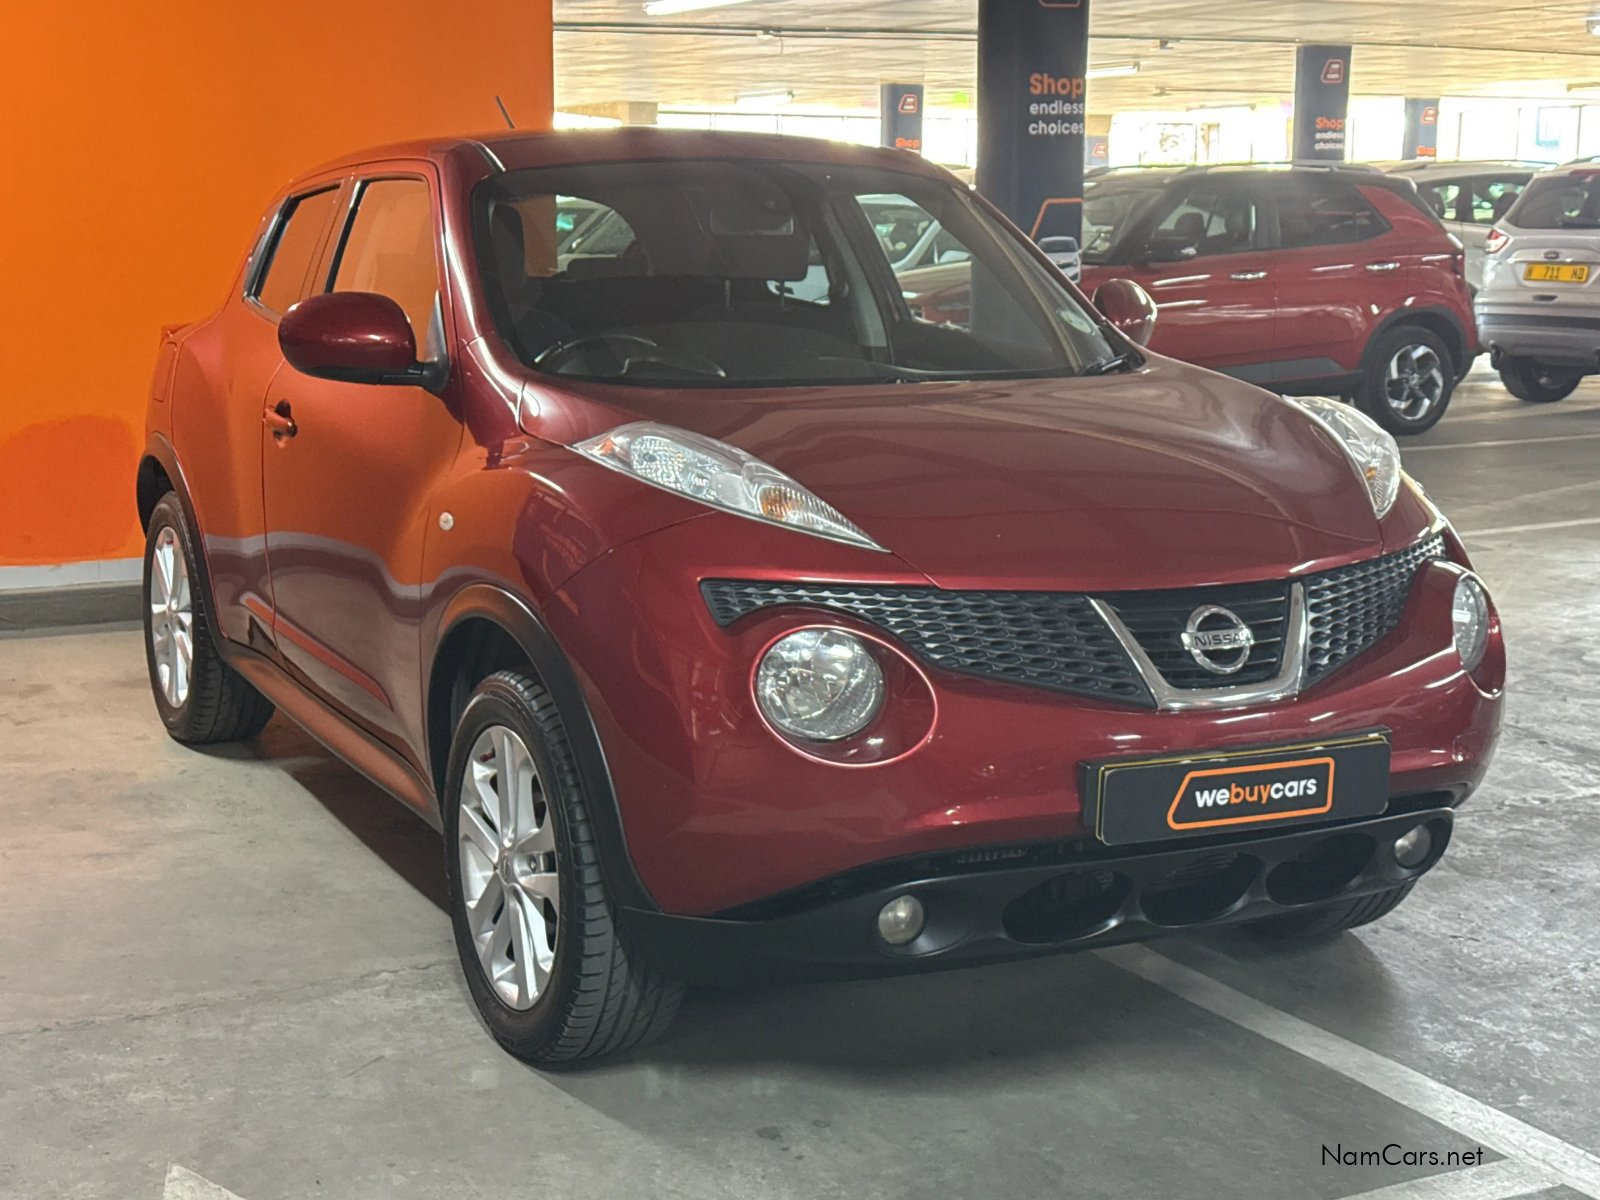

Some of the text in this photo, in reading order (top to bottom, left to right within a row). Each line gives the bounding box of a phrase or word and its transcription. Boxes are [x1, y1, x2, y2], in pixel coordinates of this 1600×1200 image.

[1029, 73, 1084, 99] Shop
[1029, 100, 1084, 115] endless
[1028, 120, 1084, 135] choices
[1315, 116, 1344, 130] Shop
[895, 137, 920, 149] Shop
[1544, 265, 1560, 280] 711
[1195, 778, 1317, 808] webuycars
